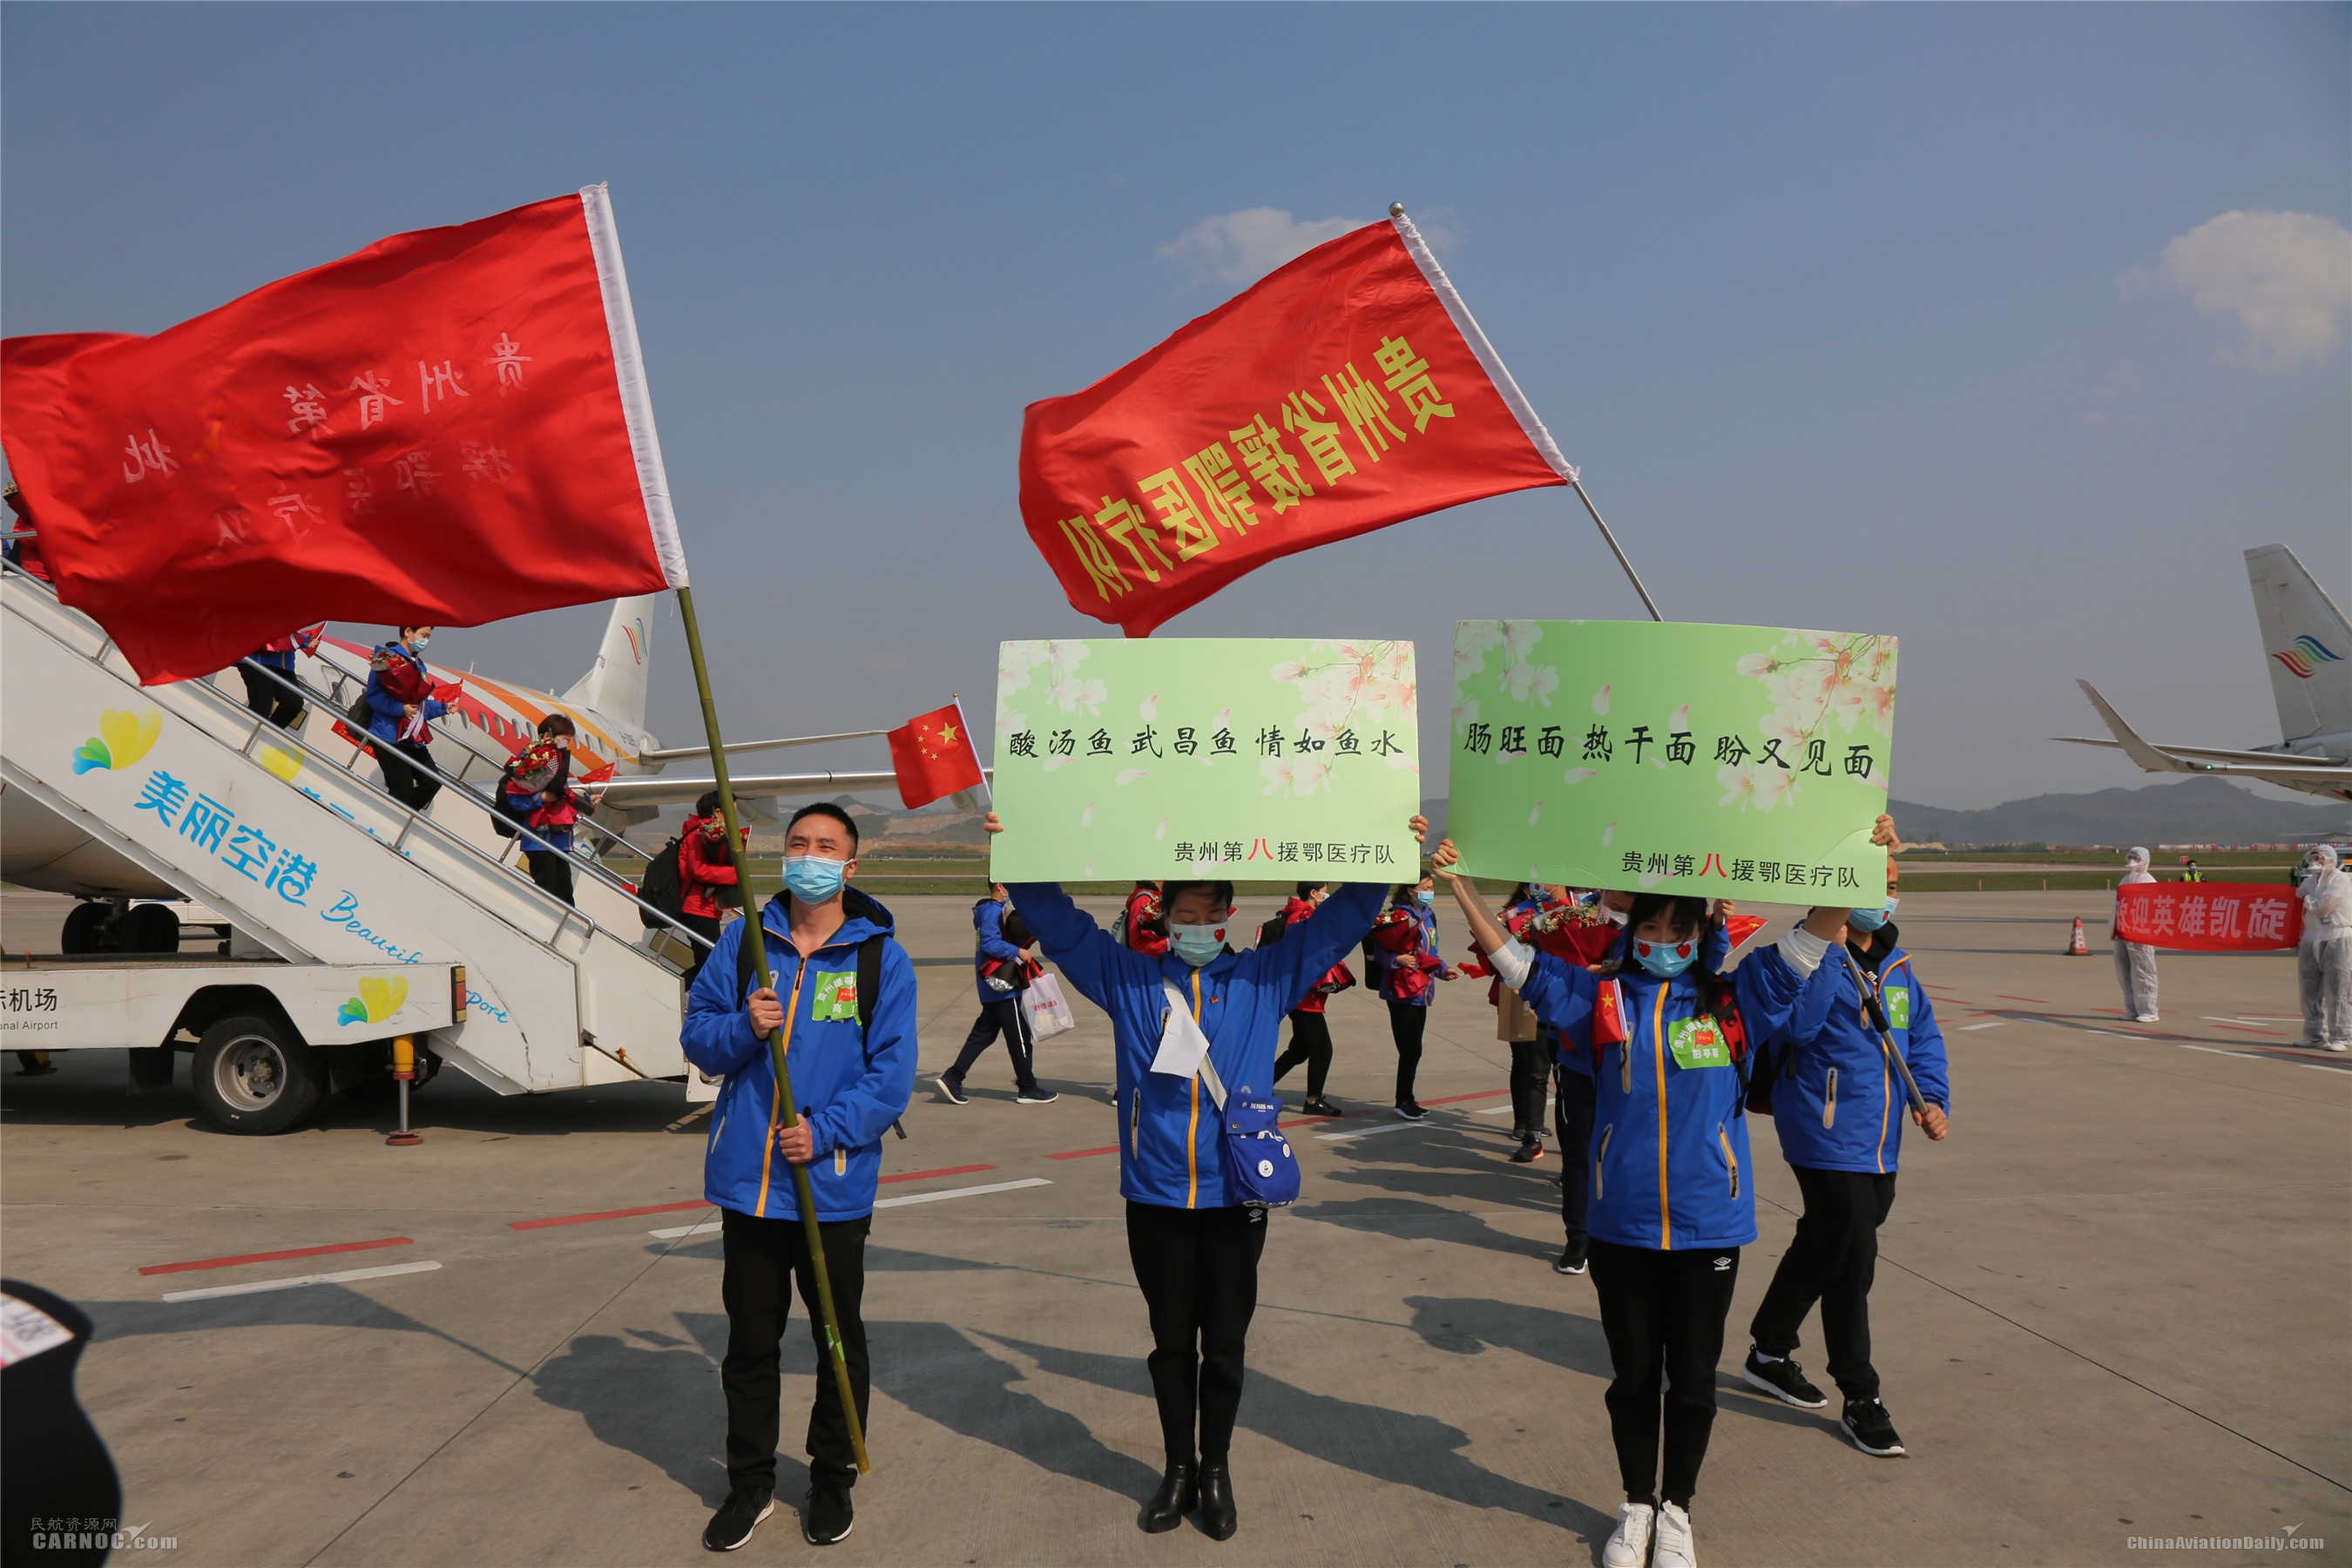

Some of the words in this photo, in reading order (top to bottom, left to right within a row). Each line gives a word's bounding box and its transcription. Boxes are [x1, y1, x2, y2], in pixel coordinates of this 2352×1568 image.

[133, 770, 318, 908] 美丽空港
[1174, 838, 1396, 865] 贵州第八援鄂医疗队
[1621, 850, 1861, 889] 贵州第八援鄂医疗队
[320, 889, 423, 964] Beautif
[23, 1020, 58, 1031] Airport
